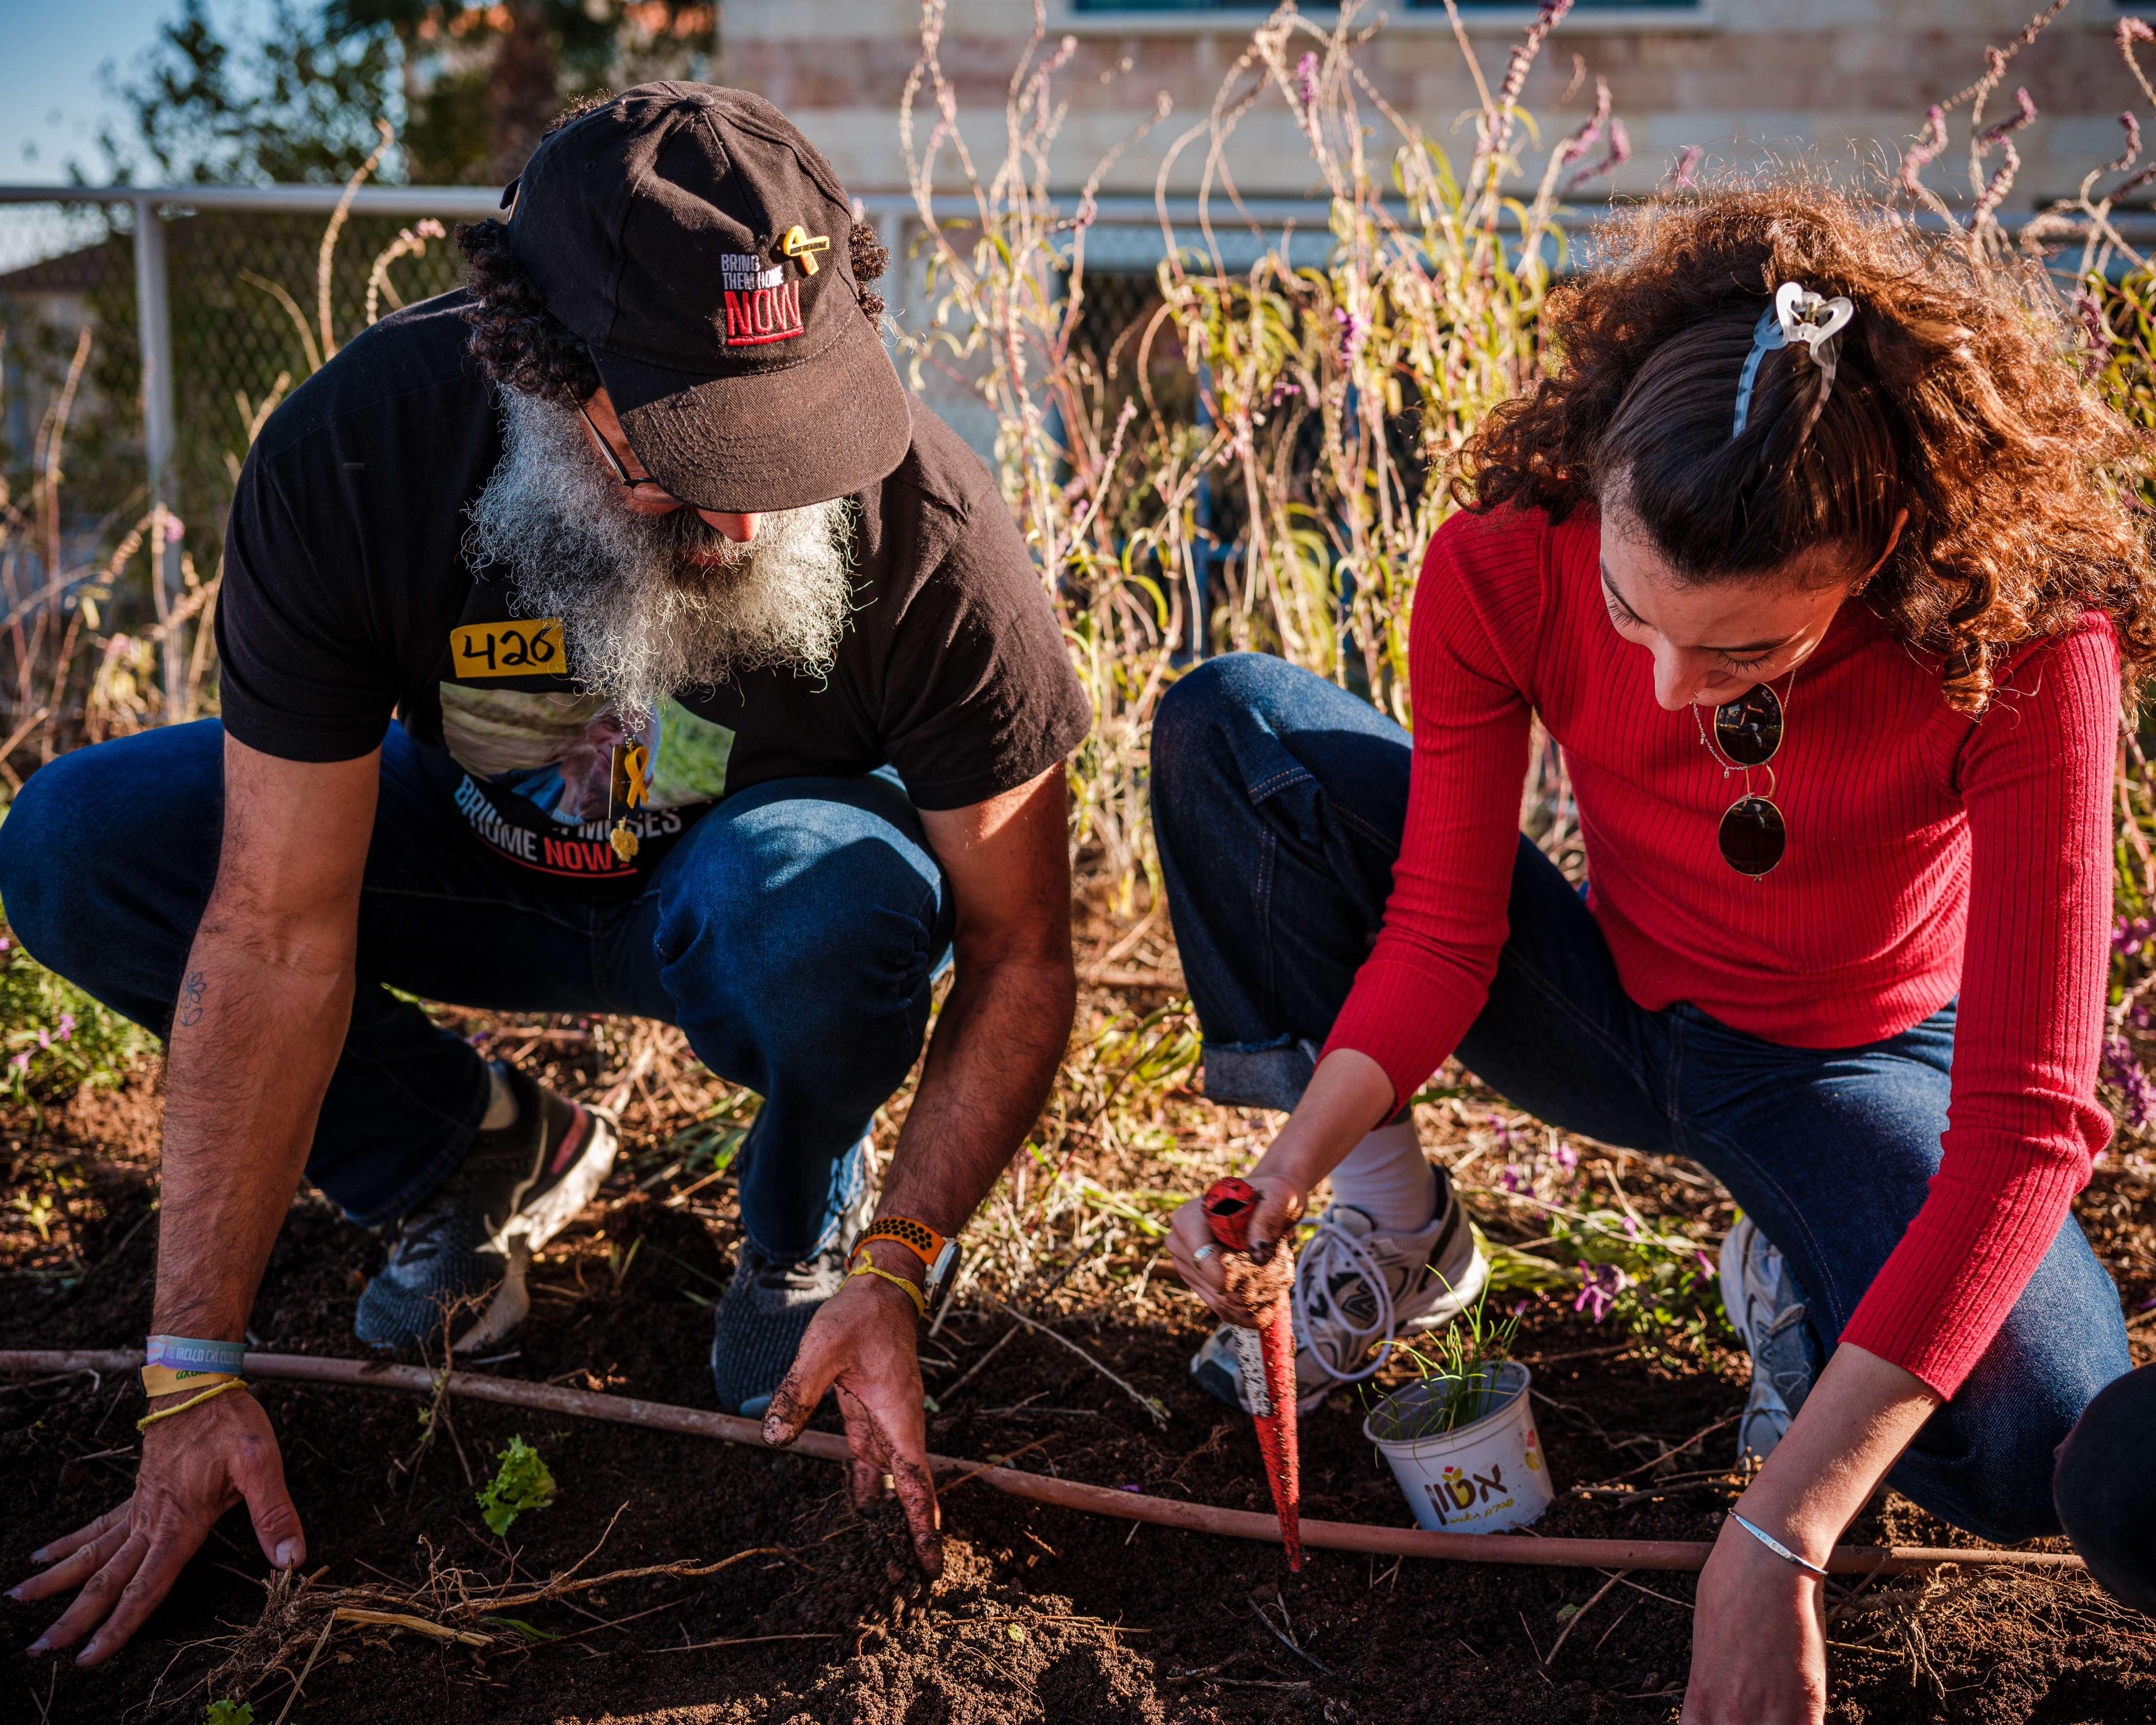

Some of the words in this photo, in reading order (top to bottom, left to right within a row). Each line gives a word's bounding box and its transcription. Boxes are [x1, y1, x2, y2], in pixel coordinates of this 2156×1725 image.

[721, 254, 760, 272] BRING
[722, 272, 755, 290] THEM
[757, 265, 784, 289] HOME
[724, 280, 802, 336] NOW
[463, 630, 555, 669] 426
[176, 1347, 204, 1363] שכולם
[205, 1348, 219, 1363] כאן
[1424, 1464, 1507, 1525] אטון
